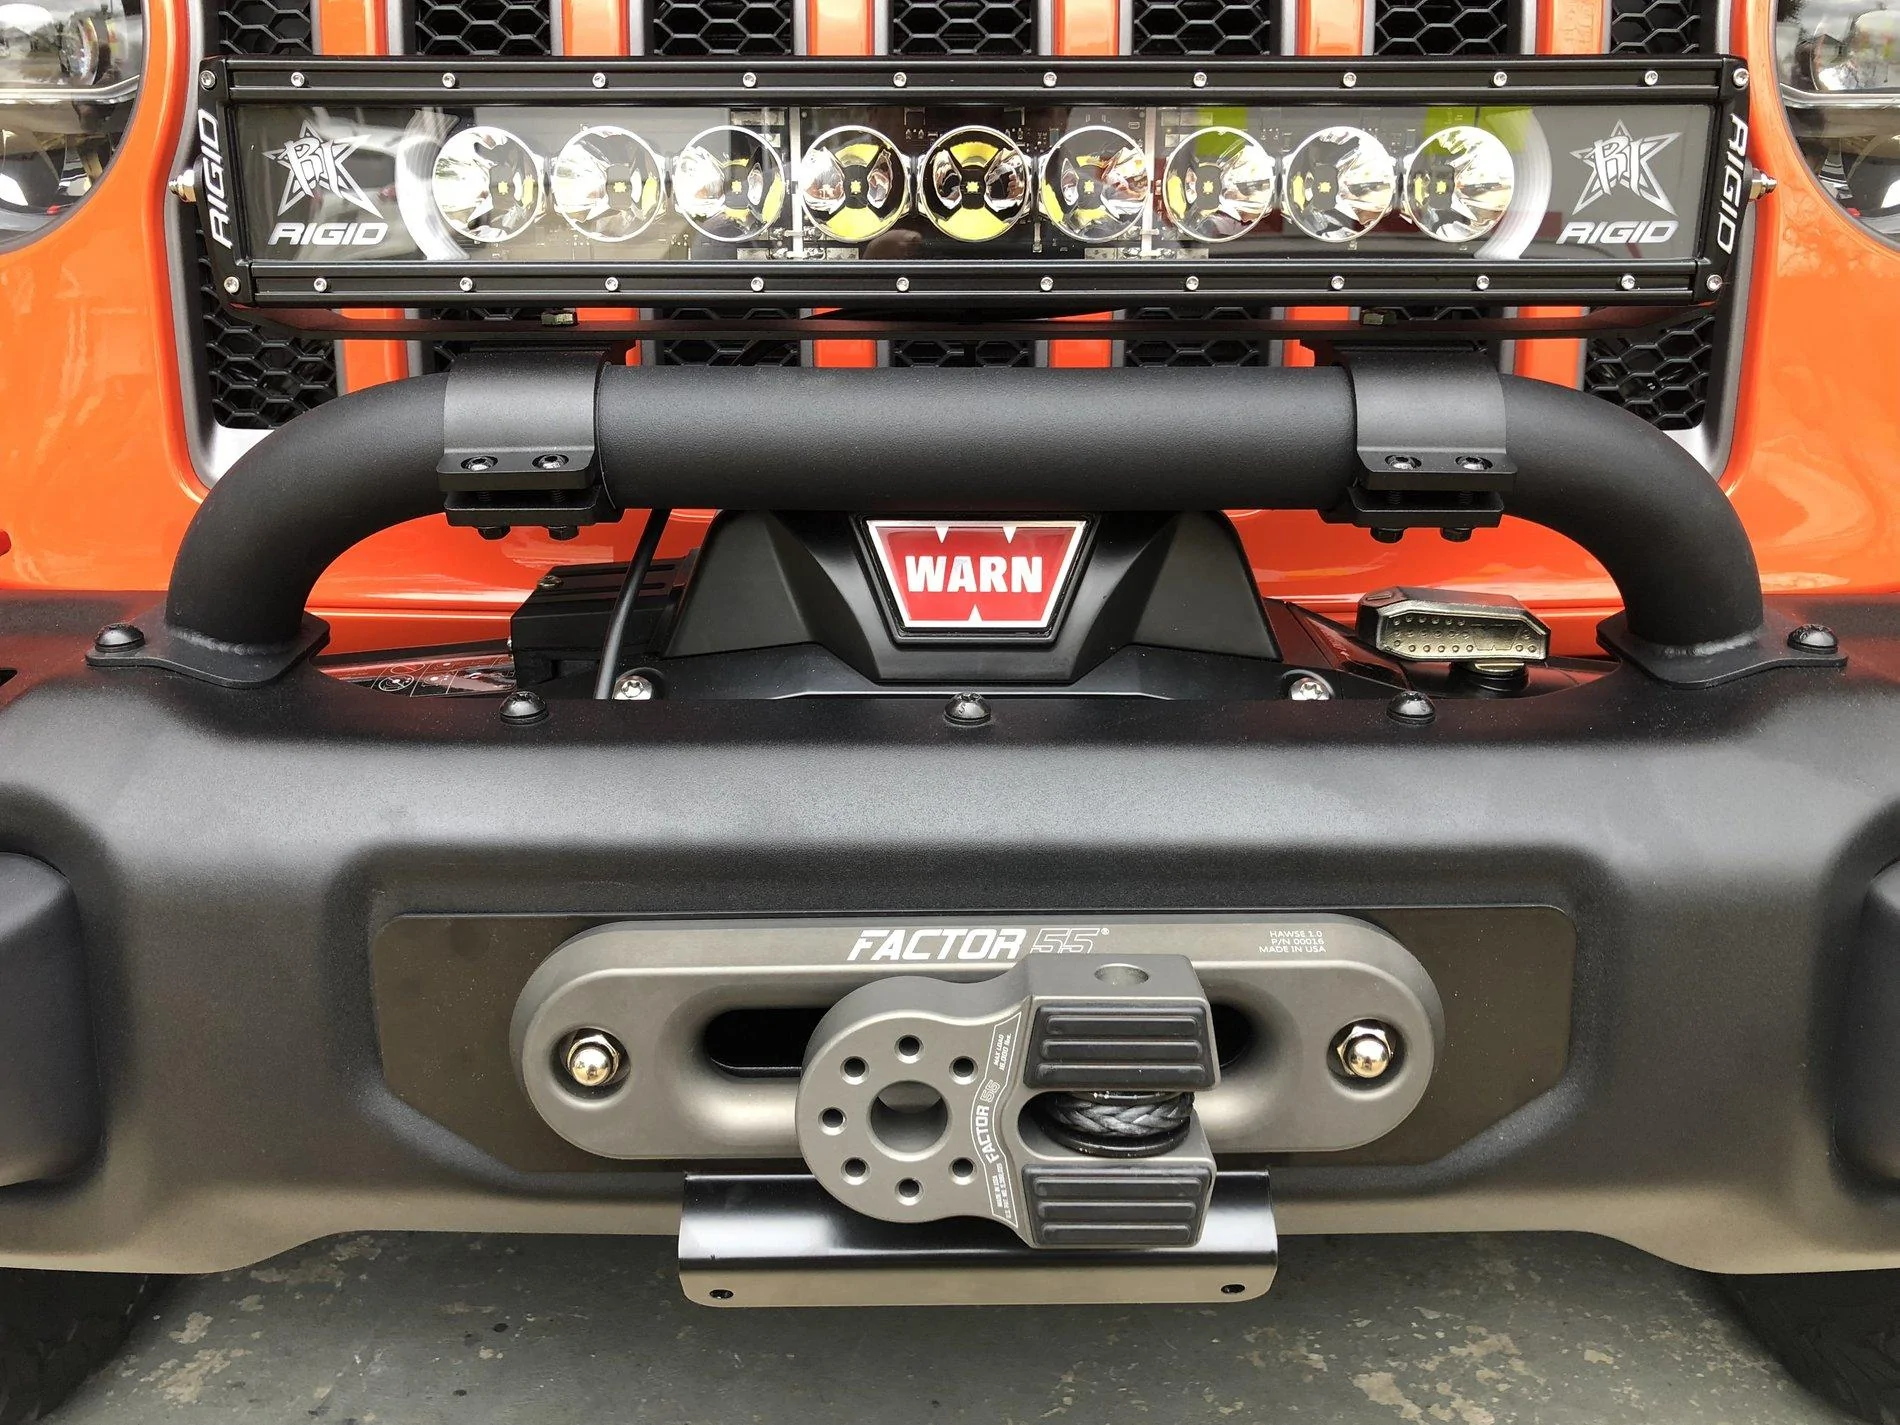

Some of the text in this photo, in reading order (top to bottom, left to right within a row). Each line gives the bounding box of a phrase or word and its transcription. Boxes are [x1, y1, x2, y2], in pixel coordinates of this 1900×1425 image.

[198, 108, 232, 249] RIGID
[1717, 113, 1748, 254] RIGID
[268, 222, 389, 245] RIGID
[1556, 220, 1679, 244] RIGID
[904, 555, 1043, 593] WARN
[847, 928, 1027, 961] FACTOR
[1259, 945, 1327, 953] MADE IN USA
[1269, 930, 1323, 938] HAWSE 1.0
[1271, 938, 1325, 946] P/N 00016
[993, 1033, 1005, 1067] MAX LOAD
[975, 1079, 1001, 1164] FACTOR 55
